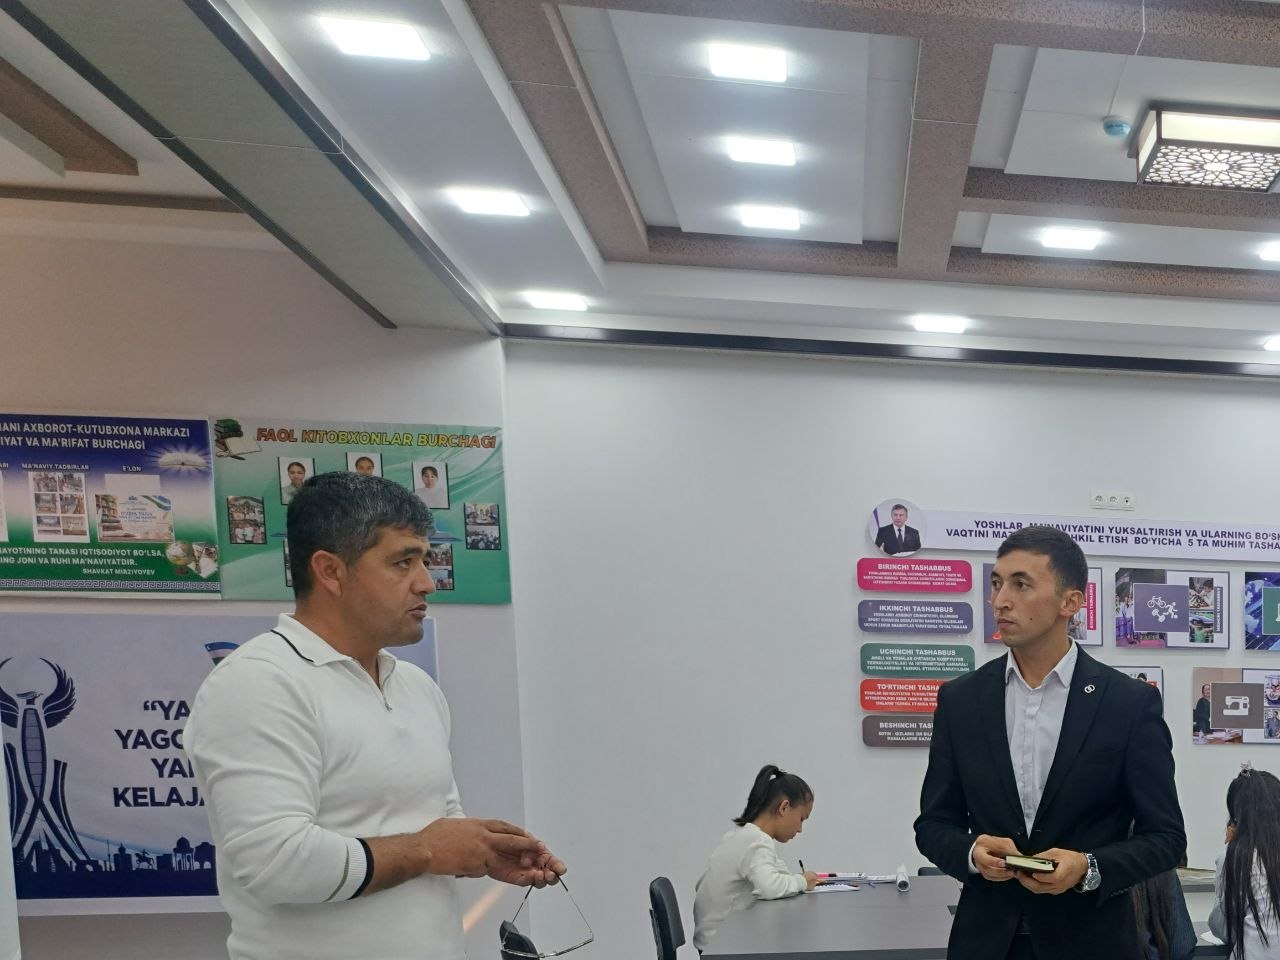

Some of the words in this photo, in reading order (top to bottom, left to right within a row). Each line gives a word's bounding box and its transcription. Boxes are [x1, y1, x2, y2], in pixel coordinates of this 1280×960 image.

[23, 422, 142, 436] AXBOROT-KUTUBXONA
[143, 426, 190, 438] MARKAZI
[25, 437, 40, 447] VA
[41, 437, 91, 449] MA'RIFAT
[92, 438, 146, 450] BURCHAGI
[256, 427, 297, 443] FAOL
[301, 429, 413, 447] KITOBXONLAR
[417, 433, 498, 449] BURCHAGI
[974, 520, 1023, 531] YOSHLAR
[1108, 526, 1182, 538] YUKSALTIRISH
[1185, 529, 1198, 538] VA
[1200, 530, 1252, 541] ULARNING
[946, 528, 989, 539] VAQTINI
[1098, 535, 1128, 544] ETISH
[1134, 536, 1183, 547] BO'YICHA
[1187, 538, 1194, 547] 5
[1197, 539, 1209, 548] TA
[1211, 539, 1246, 550] MUHIM
[49, 547, 78, 556] TANASI
[80, 547, 131, 557] IQTISODIYOT
[17, 557, 37, 565] JONI
[38, 557, 49, 565] VA
[51, 557, 71, 566] RUHI
[911, 564, 952, 572] TASHABBUS
[82, 567, 114, 576] SHAVKAT
[115, 568, 156, 577] MIRZIYOYEV
[912, 605, 954, 613] TASHABBUS
[113, 786, 205, 808] KELAJ
